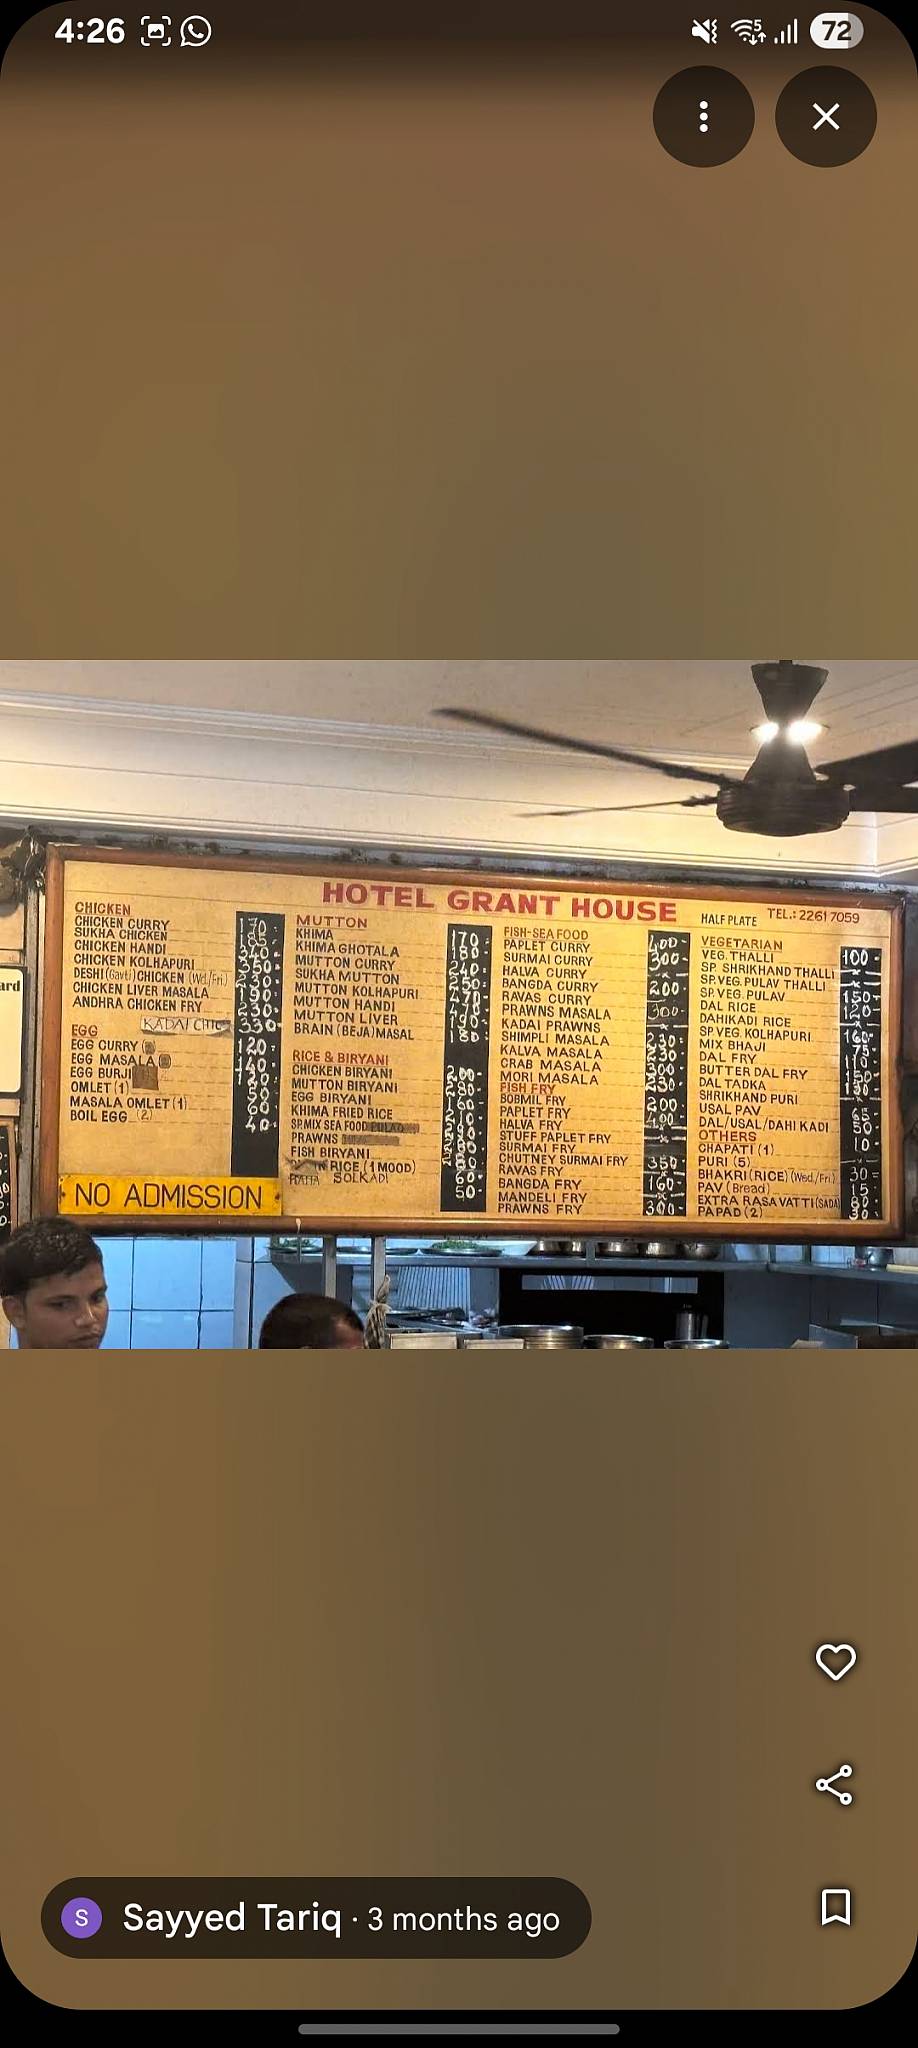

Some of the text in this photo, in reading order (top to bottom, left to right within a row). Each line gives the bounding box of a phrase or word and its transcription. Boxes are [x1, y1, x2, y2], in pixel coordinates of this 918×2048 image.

[323, 882, 677, 922] HOTEL GRANT HOUSE
[75, 902, 130, 916] CHICKEN
[75, 916, 170, 930] CHICKEN CURRY
[296, 915, 367, 928] MUTTON
[701, 913, 757, 926] HALF PLATE
[75, 928, 168, 940] SUKHA CHICKEN
[296, 928, 333, 939] KHIMA
[557, 929, 588, 940] FOOD
[74, 940, 166, 954] CHICKEN HANDI
[296, 940, 399, 957] KHIMA GHOTALA
[504, 939, 590, 953] PAPLET CURRY
[702, 936, 783, 950] VEGETARIAN
[73, 954, 194, 970] CHICKEN KOLHAPURI
[295, 954, 395, 971] MUTTON CURRY
[504, 952, 593, 966] SURMAI CURRY
[702, 950, 774, 963] VEG. THALLI
[295, 968, 399, 984] SUKHA MUTTON
[73, 981, 209, 999] CHICKEN LIVER MASALA
[295, 982, 419, 1000] MUTTON KOLHAPURI
[502, 978, 598, 992] BANGDA CURRY
[73, 995, 202, 1012] ANDHRA CHICKEN FRY
[294, 995, 395, 1012] MUTTON HANDI
[700, 1000, 756, 1012] DAL RICE
[294, 1010, 398, 1025] MUTTON LIVER
[502, 1004, 611, 1020] PRAWNS MASALA
[700, 1013, 791, 1027] DAHIKADI RICE
[71, 1024, 98, 1036] EGG
[294, 1023, 333, 1035] BRAIN
[71, 1039, 138, 1051] EGG CURRY
[502, 1031, 609, 1046] SHIMPLI MASALA
[501, 1044, 602, 1059] KALVA MASALA
[700, 1039, 766, 1052] MIX BHAJI
[71, 1053, 155, 1066] EGG MASALA
[293, 1050, 389, 1065] RICE & BIRYANI
[292, 1064, 392, 1079] CHICKEN BIRYANI
[501, 1058, 601, 1072] CRAB MASALA
[700, 1064, 808, 1079] BUTTER DAL FRY
[70, 1067, 92, 1078] EGG
[98, 1068, 132, 1079] BURJI
[71, 1081, 129, 1094] OMLET (1)
[292, 1078, 398, 1093] MUTTON BIRYANI
[500, 1083, 556, 1095] FISH FRY
[700, 1078, 766, 1090] DAL TADKA
[70, 1096, 187, 1111] MASALA OMLET (1)
[291, 1092, 371, 1105] EGG BIRYANI
[500, 1094, 566, 1106] BOBMIL FRY
[700, 1090, 798, 1104] SHRIKHAND PURI
[70, 1109, 152, 1123] BOIL EGG (2)
[291, 1105, 392, 1119] KHIMA FRIED RICE
[500, 1106, 571, 1119] PAPLET FRY
[700, 1104, 761, 1115] USAL PAV
[800, 1121, 828, 1133] KADI
[291, 1132, 338, 1144] PRAWNS
[500, 1131, 611, 1144] STUFF PAPLET FRY
[699, 1130, 756, 1141] OTHERS
[291, 1146, 370, 1159] FISH BIRYANI
[699, 1144, 774, 1156] CHAPATI (1)
[499, 1153, 628, 1166] CHUTNEY SURMAI FRY
[698, 1157, 750, 1168] PURI (5)
[498, 1178, 582, 1190] BANGDA FRY
[698, 1182, 770, 1194] PAV (Bread)
[75, 1182, 262, 1209] NO ADMISSION
[498, 1192, 587, 1203] MANDELI FRY
[498, 1203, 583, 1215] PRAWNS FRY
[698, 1206, 763, 1218] PAPAD (2)
